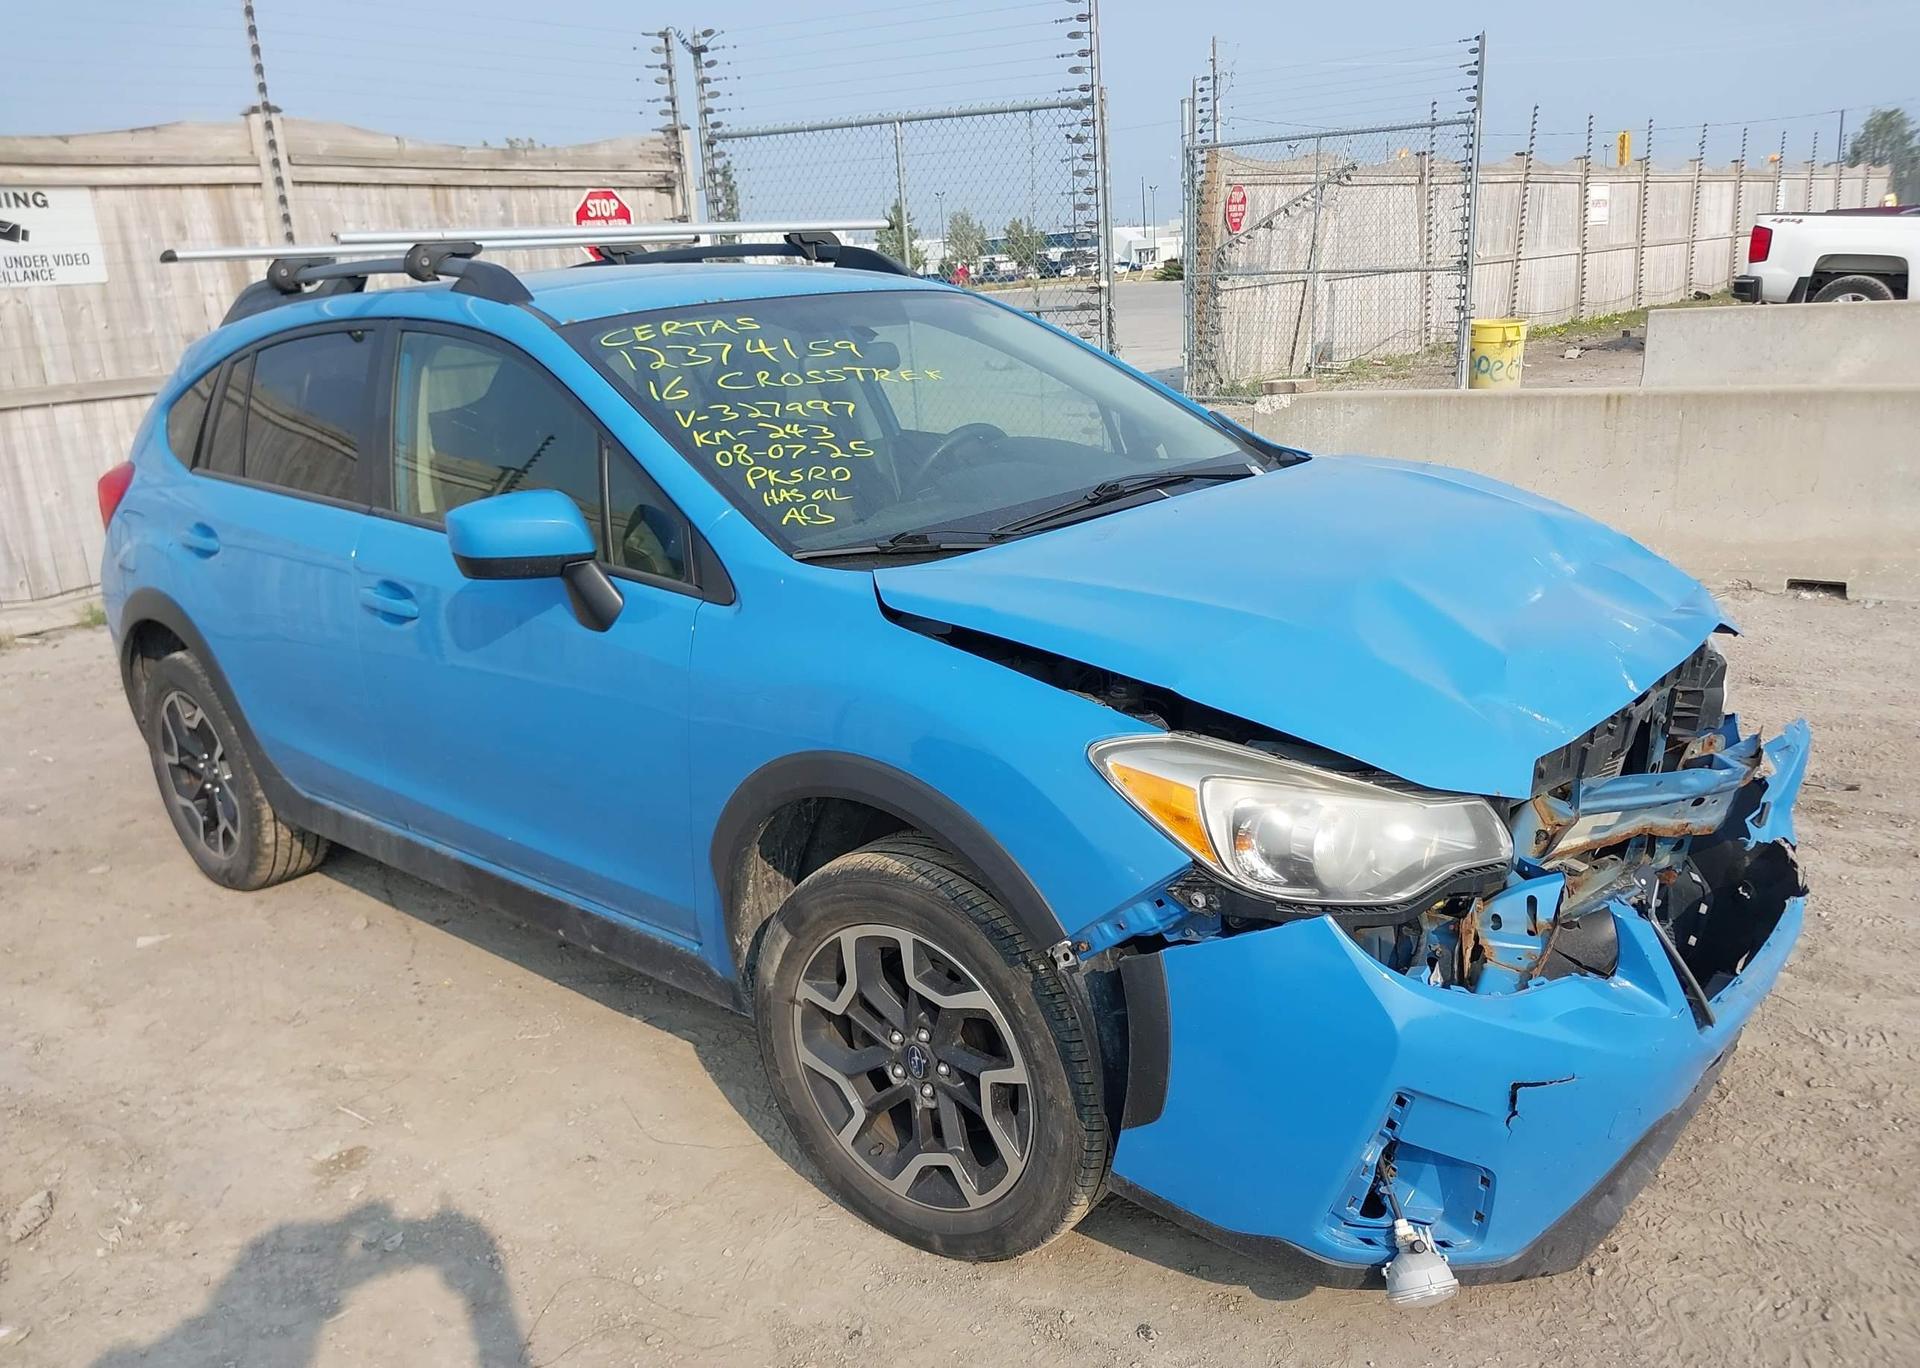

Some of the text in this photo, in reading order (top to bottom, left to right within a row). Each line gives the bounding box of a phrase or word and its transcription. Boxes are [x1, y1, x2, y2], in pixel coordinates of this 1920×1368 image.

[586, 198, 619, 218] STOP
[3, 252, 90, 268] UNDER VIDEO
[0, 268, 56, 283] ILLANCE
[600, 317, 761, 346] CERTAS
[618, 338, 864, 371] 12374159
[649, 375, 690, 401] 16
[715, 440, 875, 467] 08-07-25
[763, 487, 807, 507] HAS
